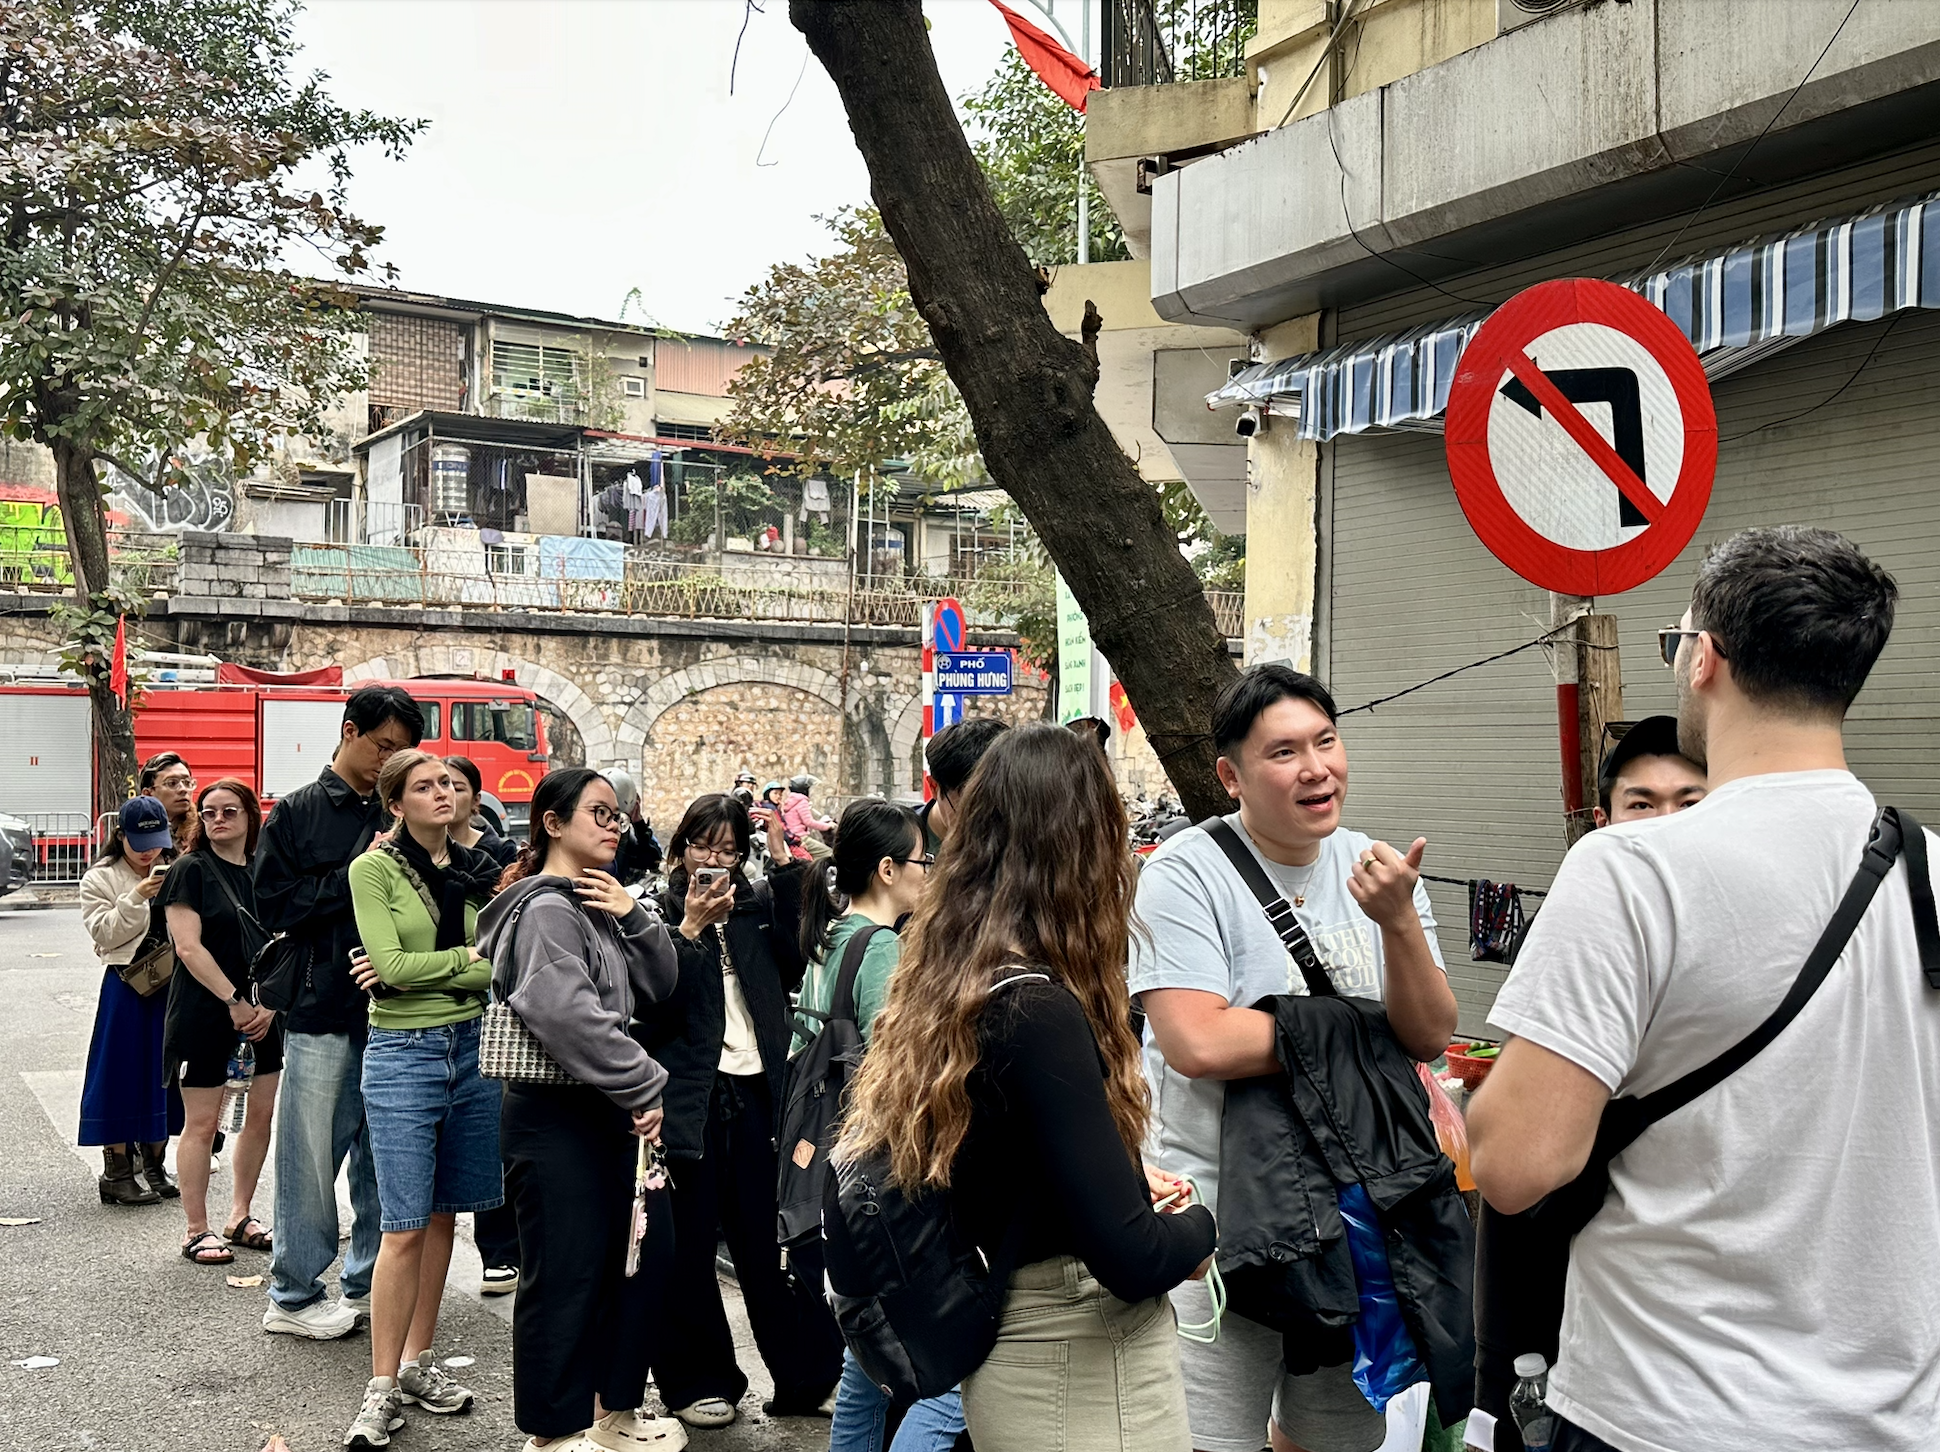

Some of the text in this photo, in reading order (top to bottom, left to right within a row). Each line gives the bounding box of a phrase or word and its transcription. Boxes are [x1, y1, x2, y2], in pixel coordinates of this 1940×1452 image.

[960, 657, 985, 669] PHỐ
[939, 669, 1007, 687] PHÙNG HƯNG
